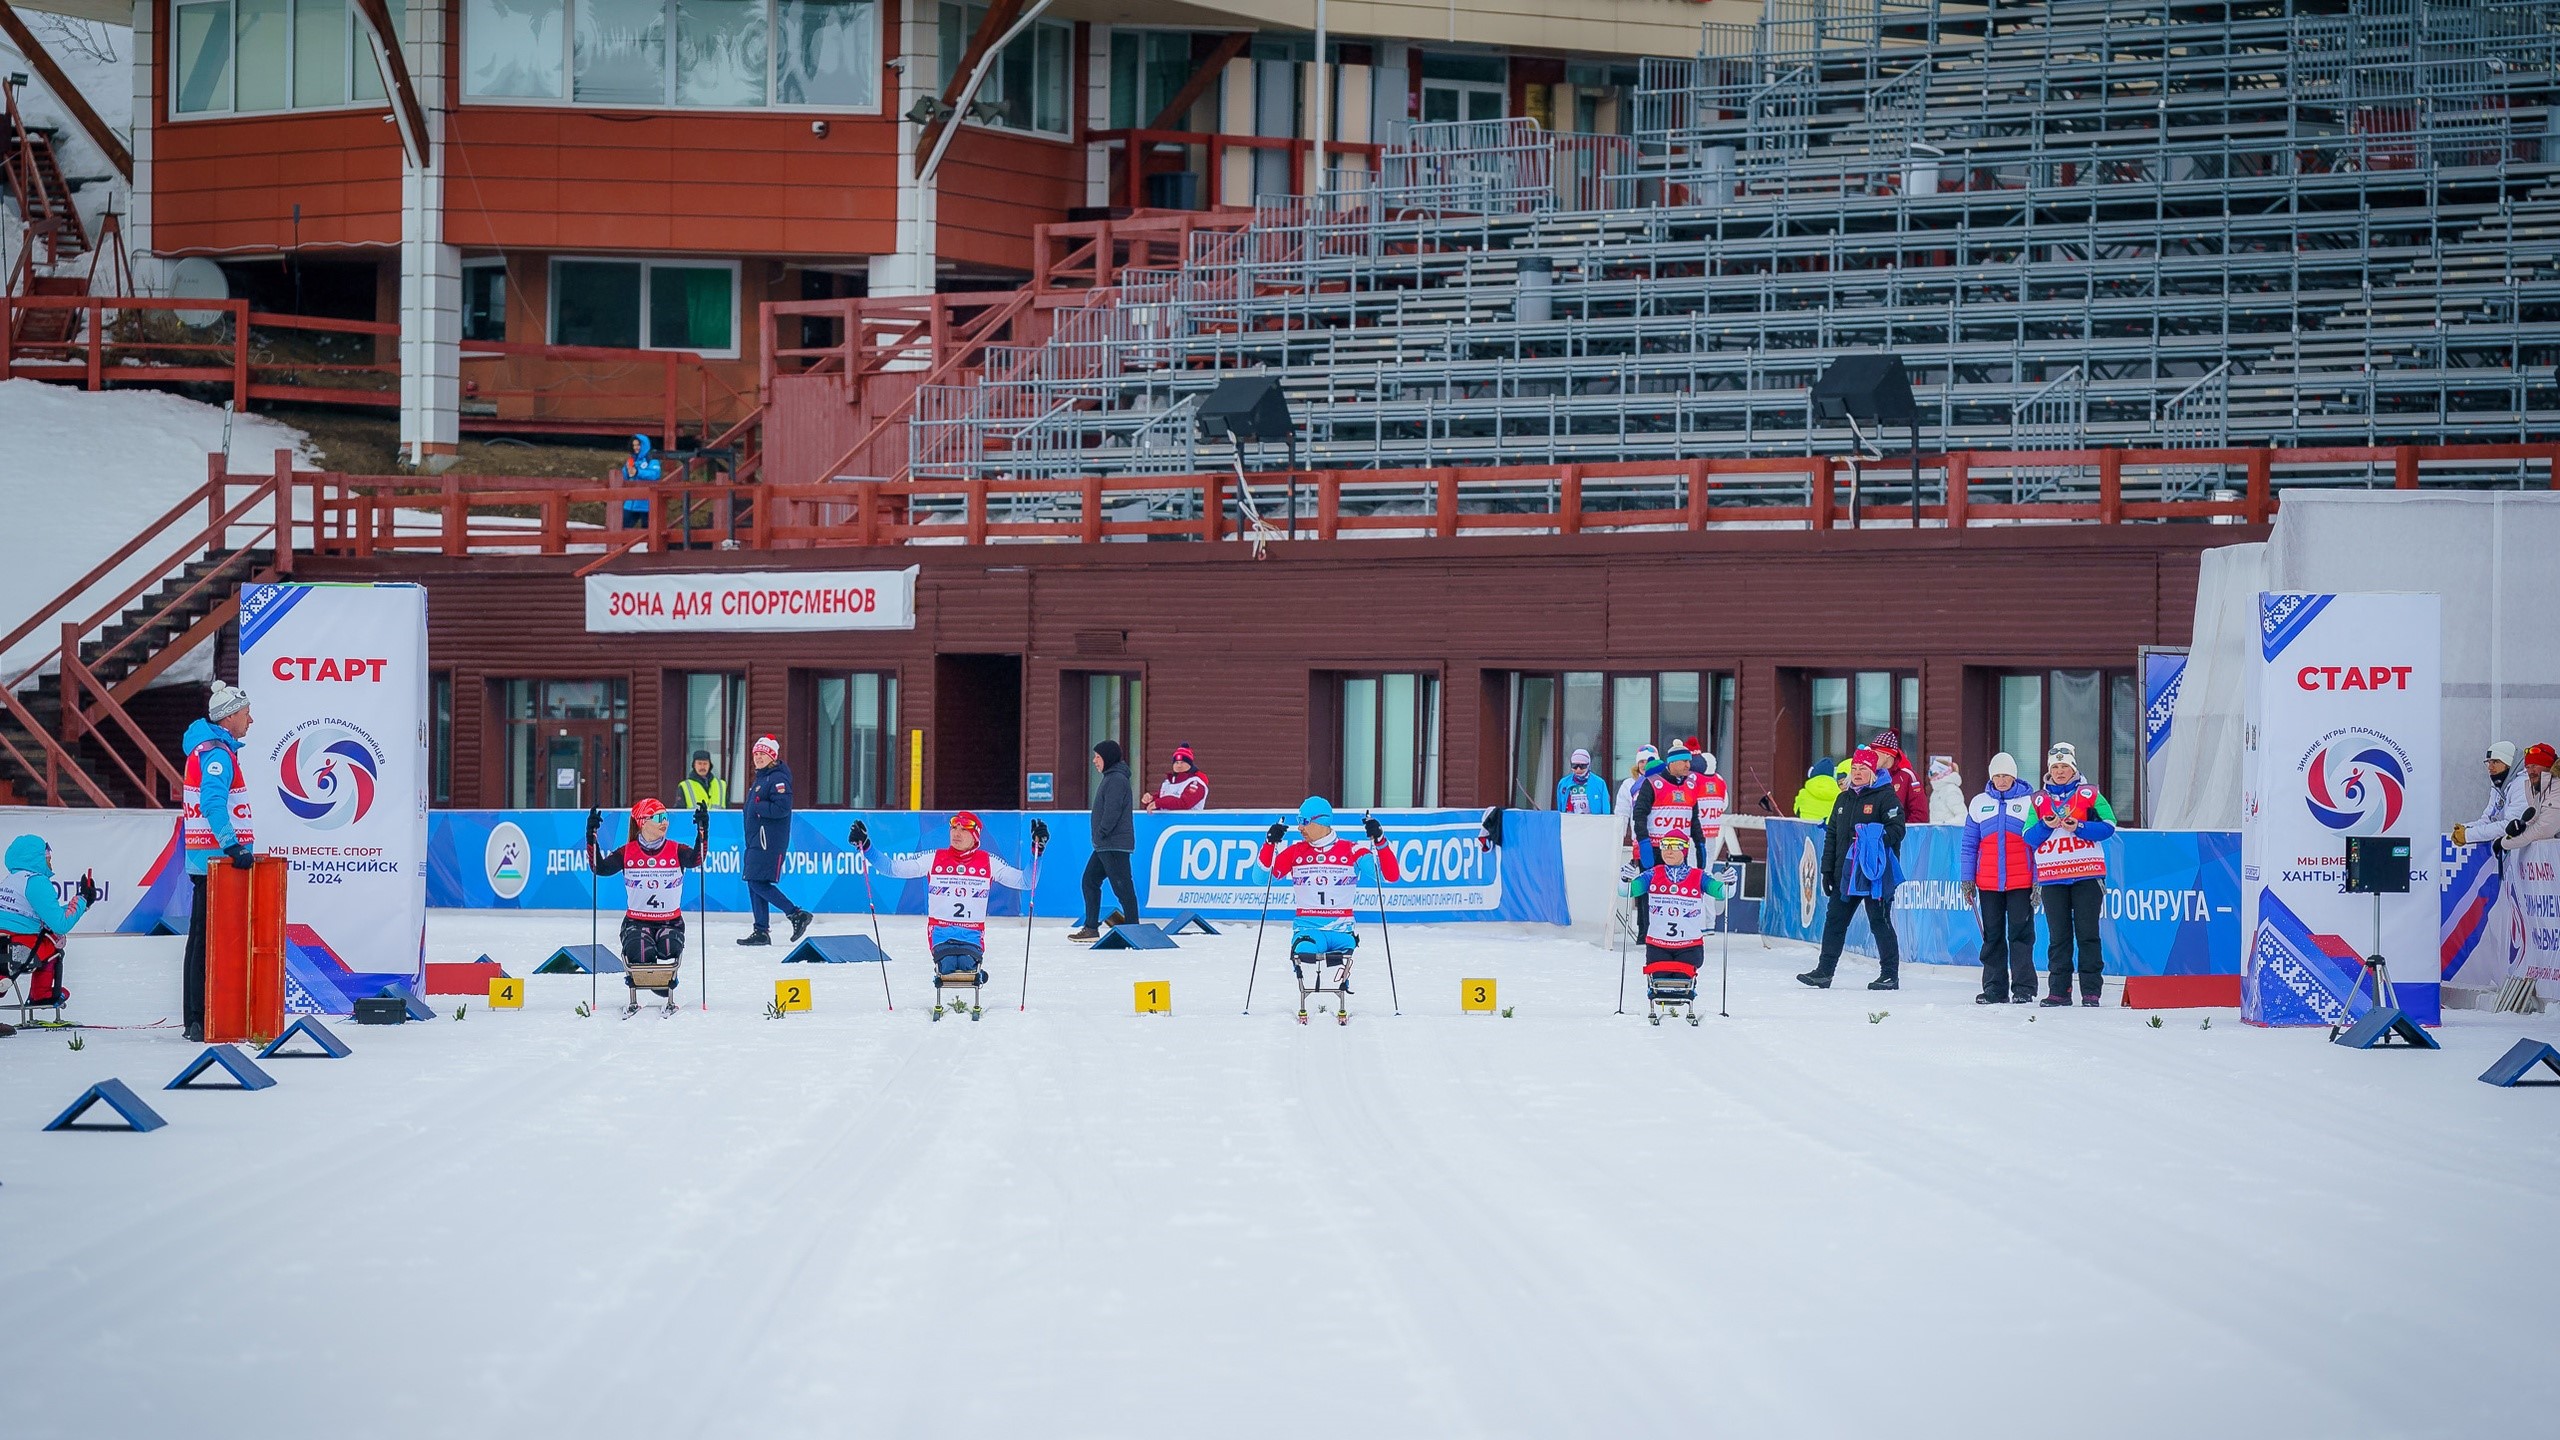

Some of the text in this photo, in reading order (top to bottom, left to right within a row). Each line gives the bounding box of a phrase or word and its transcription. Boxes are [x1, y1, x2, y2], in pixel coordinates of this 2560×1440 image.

[609, 588, 876, 619] ЗОНА ДЛЯ СПОРТСМЕНОВ
[272, 657, 388, 683] СТАРТ
[2297, 666, 2413, 690] СТАРТ
[269, 730, 295, 762] ЗИМНИЕ
[296, 718, 320, 732] ИГРЫ
[324, 717, 386, 765] ПАРАЛИМПИЙЦЕВ
[2297, 726, 2414, 773] ЗИМНИЕ ИГРЫ ПАРАЛИМПИЙЦЕВ
[268, 846, 383, 857] МЫ ВМЕСТЕ. СПОРТ
[286, 859, 398, 873] ТЫ-МАНСИЙСК
[822, 852, 833, 875] И
[2297, 857, 2318, 866] МЫ
[308, 873, 343, 884] 2024
[646, 894, 660, 908] 4
[1178, 892, 1233, 905] АВТОНОМНОЕ
[1234, 891, 1291, 907] УЧРЕЖДЕНИЕ
[1317, 891, 1325, 905] 1
[2125, 888, 2211, 922] ОКРУГА
[953, 903, 965, 918] 2
[1665, 921, 1678, 936] 3
[501, 985, 513, 1000] 4
[788, 987, 800, 1003] 2
[1148, 988, 1156, 1004] 1
[1474, 987, 1486, 1003] 3
